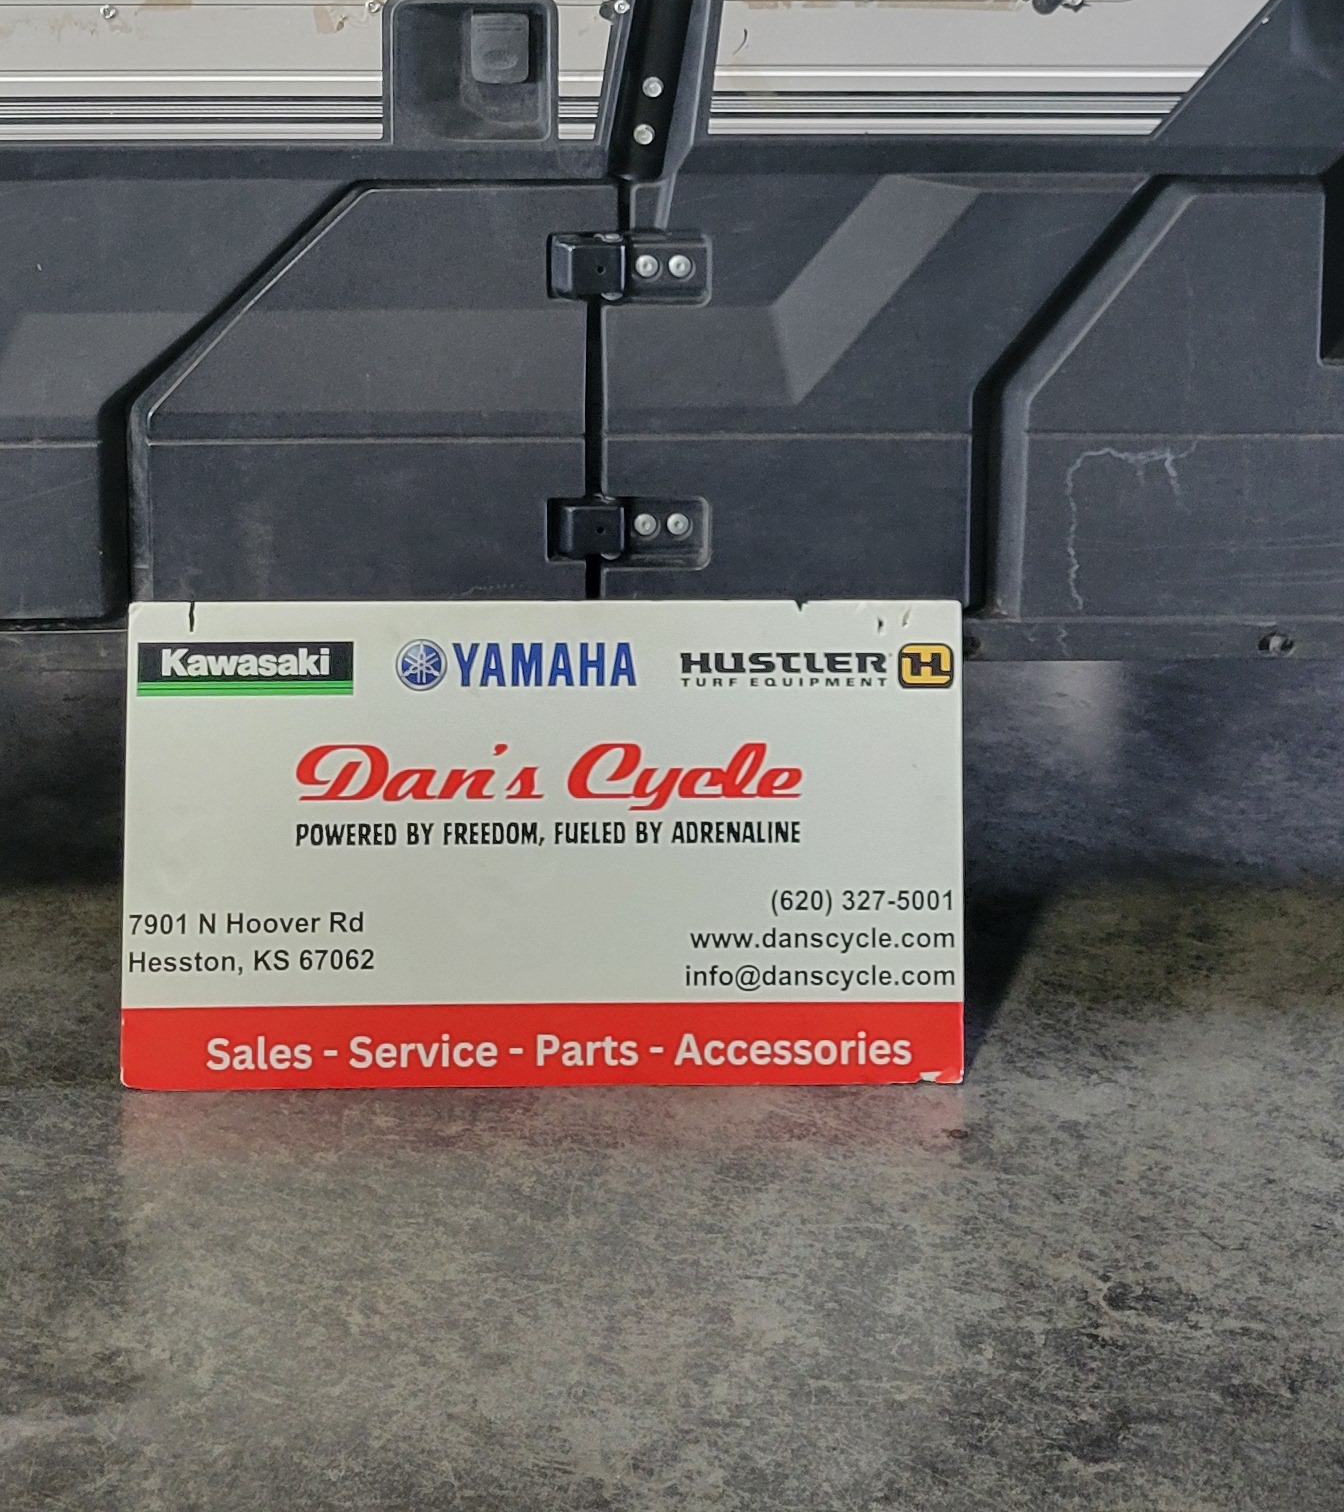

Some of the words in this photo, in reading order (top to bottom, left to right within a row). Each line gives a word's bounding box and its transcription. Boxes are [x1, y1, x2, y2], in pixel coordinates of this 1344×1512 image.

[161, 647, 330, 677] Kawasaki
[452, 642, 636, 687] YAMAHA
[680, 652, 887, 674] HUSTLER
[682, 677, 737, 688] TURF
[750, 677, 887, 688] EQUIPMENT
[295, 743, 544, 802] Dan's
[567, 742, 803, 811] Cycle
[295, 822, 397, 847] POWERED
[406, 822, 434, 846] BY
[443, 821, 545, 847] FREEDOM,
[554, 821, 626, 845] FUELED
[636, 820, 663, 844] BY
[671, 821, 800, 844] ADRENALINE
[771, 889, 832, 917] (620)
[842, 889, 952, 911] 327-5001
[129, 913, 186, 935] 7901
[199, 913, 216, 935] N
[227, 912, 321, 934] Hoover
[329, 911, 364, 933] Rd
[690, 927, 955, 954] www.danscycle.com
[129, 951, 243, 976] Hesston,
[254, 949, 290, 971] KS
[299, 948, 374, 971] 67062
[686, 964, 955, 992] info@danscycle.com
[206, 1035, 313, 1071] Sales
[349, 1033, 498, 1069] Service
[536, 1034, 639, 1067] Parts
[674, 1031, 912, 1066] Accessories
